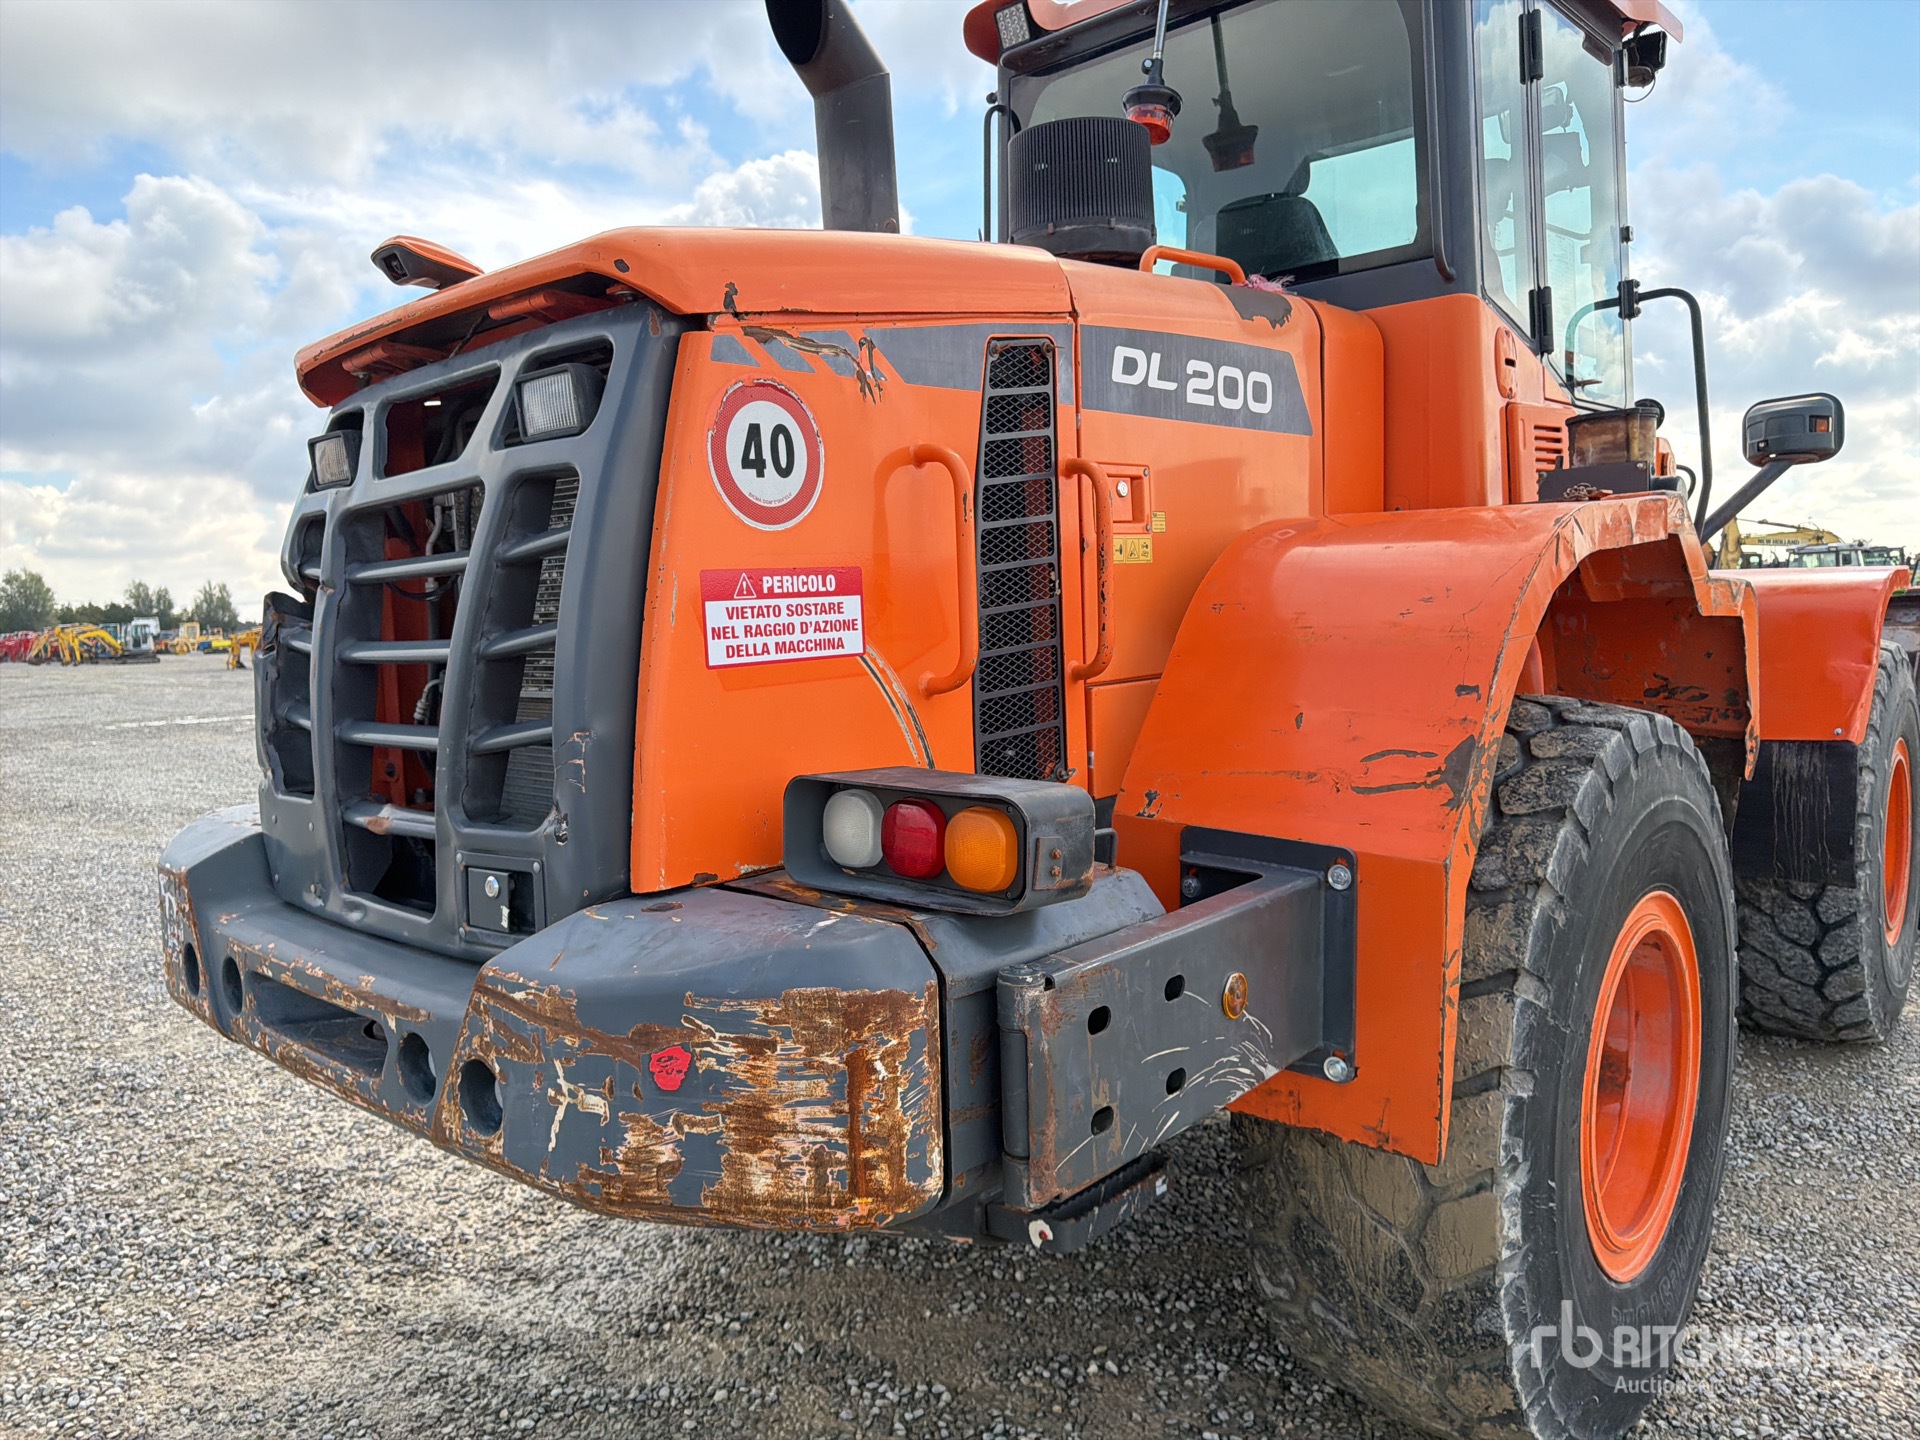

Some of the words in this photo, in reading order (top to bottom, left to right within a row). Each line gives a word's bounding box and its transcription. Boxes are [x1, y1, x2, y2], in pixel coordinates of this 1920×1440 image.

[1111, 345, 1178, 391] DL
[1186, 359, 1273, 414] 200
[741, 422, 795, 478] 40
[762, 574, 836, 594] PERICOLO
[725, 604, 782, 621] VIETATO
[785, 601, 845, 618] SOSTARE
[711, 624, 740, 641] NEL
[743, 621, 796, 639] RAGGIO
[799, 617, 859, 636] D'AZIONE
[725, 641, 771, 659] DELLA
[774, 636, 845, 656] MACCHINA
